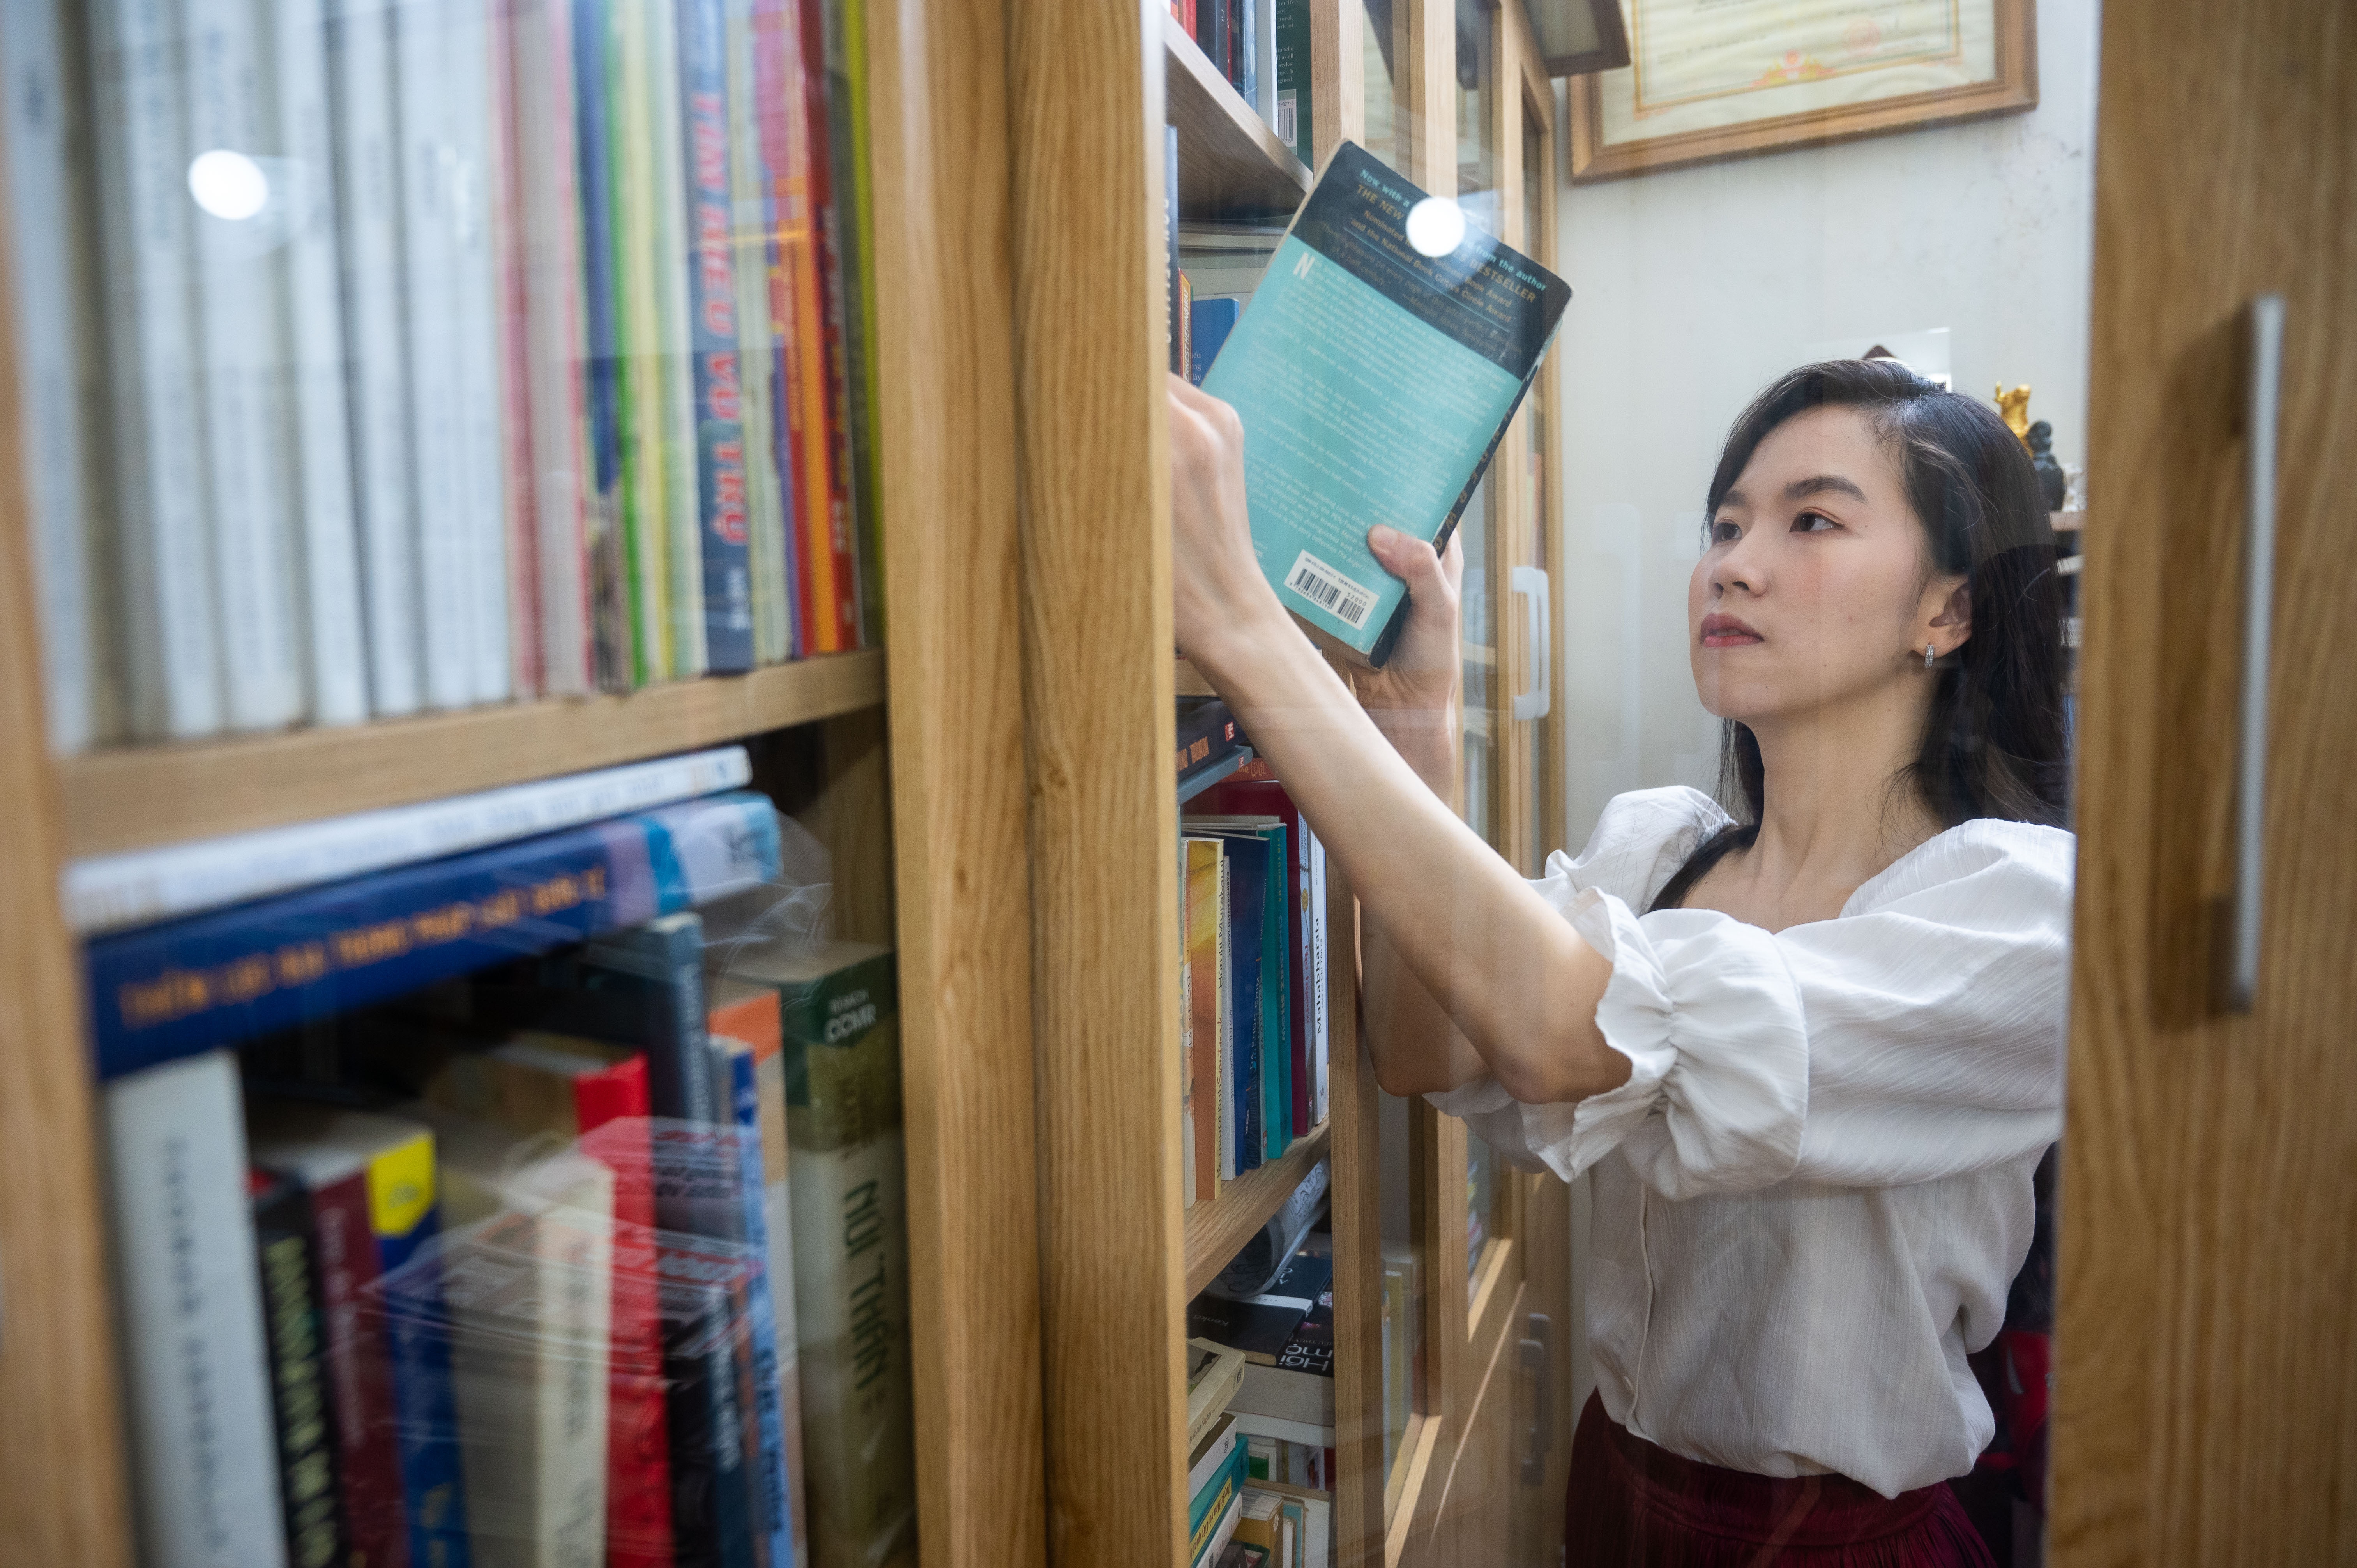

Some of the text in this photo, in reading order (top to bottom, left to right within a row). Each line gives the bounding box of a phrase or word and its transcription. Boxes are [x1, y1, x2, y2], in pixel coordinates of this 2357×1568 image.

[1350, 218, 1367, 232] and
[1366, 228, 1381, 241] the
[1380, 238, 1414, 263] National
[1412, 259, 1435, 277] Book
[1460, 288, 1486, 308] Circle
[1484, 302, 1512, 324] Award
[1355, 184, 1379, 204] THE
[1378, 200, 1405, 222] NEW
[1468, 256, 1537, 305] BESTSELLER
[1359, 168, 1382, 188] Now
[1380, 184, 1403, 202] with
[1402, 199, 1410, 208] a
[1475, 244, 1498, 263] from
[1497, 258, 1516, 274] the
[1515, 268, 1548, 293] author
[1361, 209, 1406, 242] Nominated
[1463, 275, 1486, 293] Book
[1485, 287, 1512, 309] Award
[1346, 592, 1367, 607] 52000
[1279, 1354, 1329, 1371] Hồi
